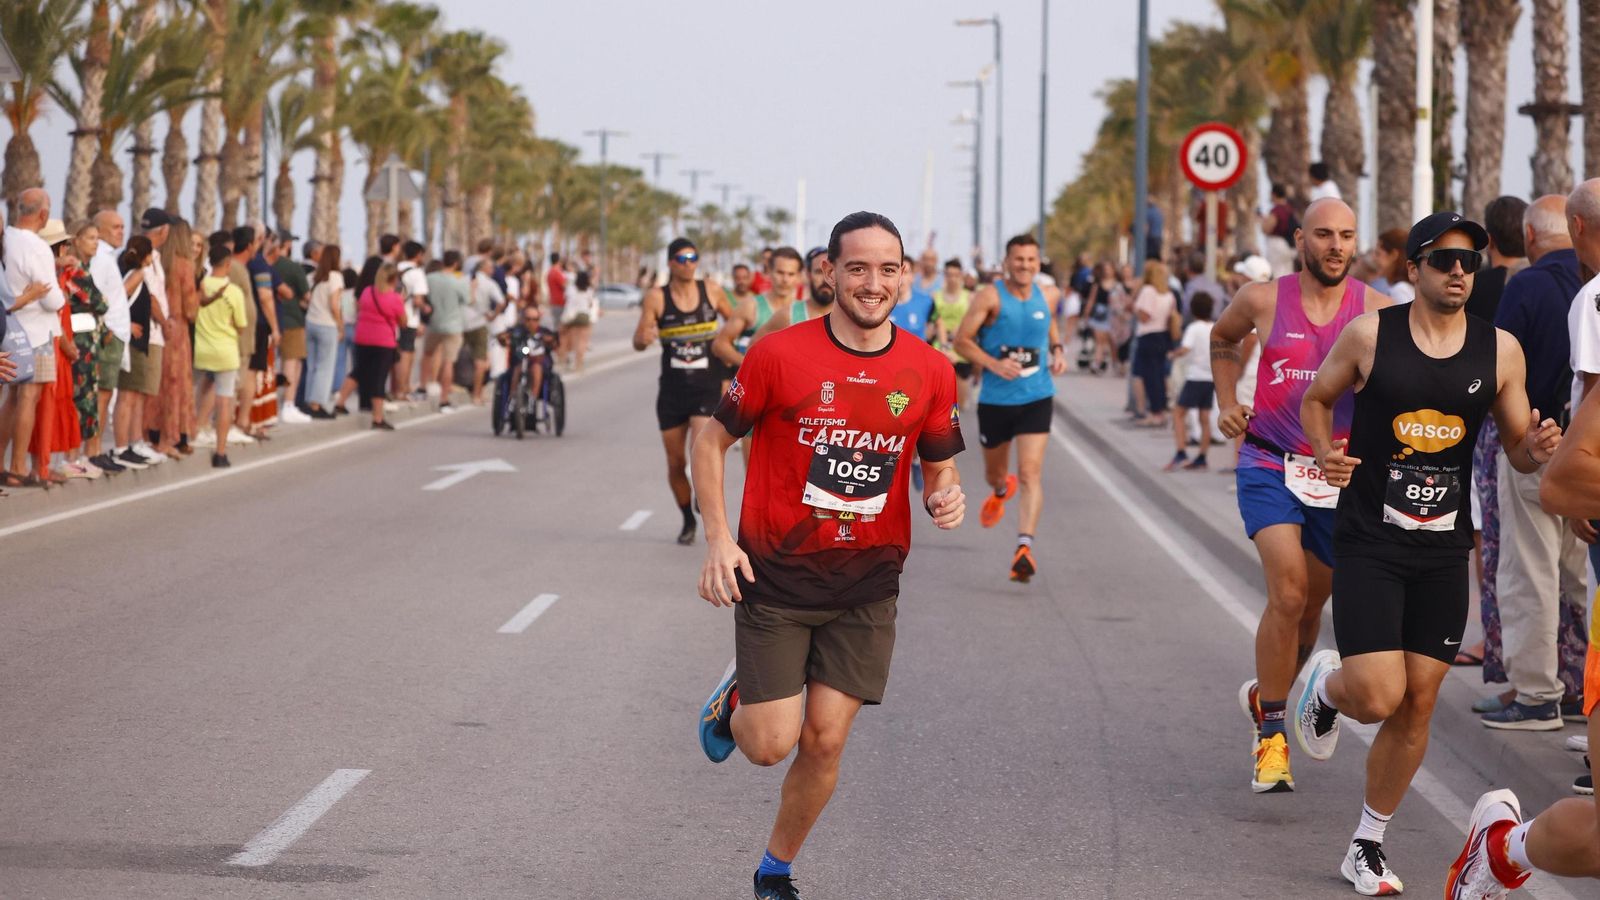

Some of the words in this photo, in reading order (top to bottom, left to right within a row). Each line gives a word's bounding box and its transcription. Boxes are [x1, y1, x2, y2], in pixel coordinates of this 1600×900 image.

[1195, 144, 1229, 168] 40
[798, 417, 847, 427] ATLETISMO
[1398, 421, 1462, 439] vasco
[827, 458, 882, 482] 1065
[1405, 484, 1448, 502] 897
